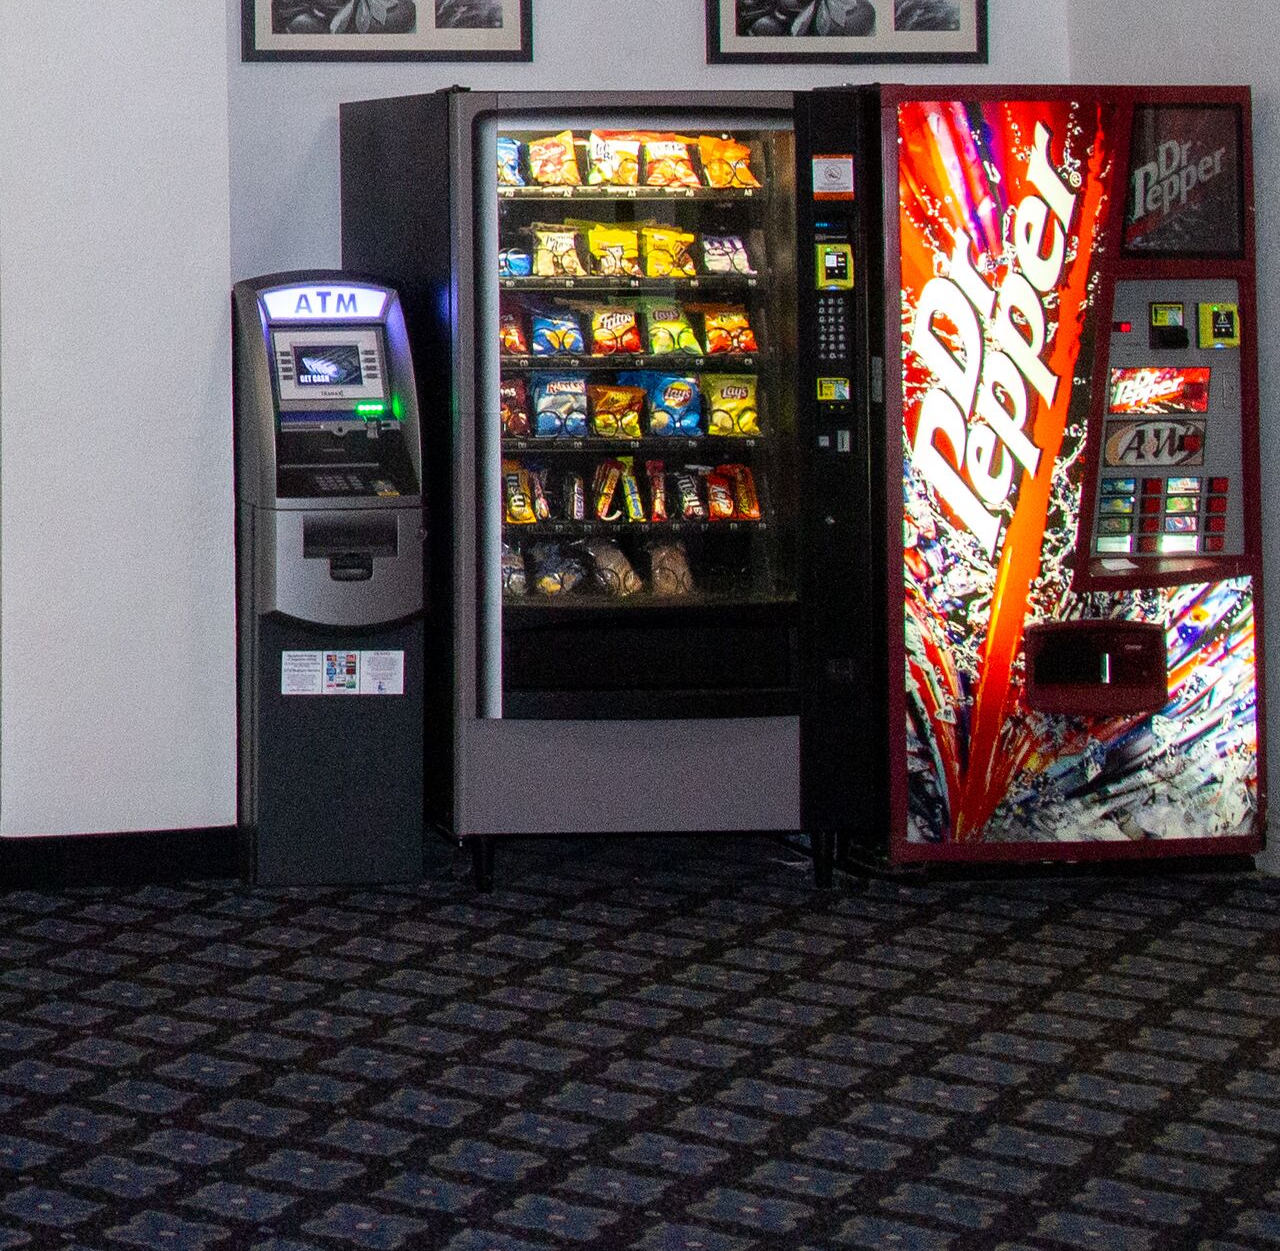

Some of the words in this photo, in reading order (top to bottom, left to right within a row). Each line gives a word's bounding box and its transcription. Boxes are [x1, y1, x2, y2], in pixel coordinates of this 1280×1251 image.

[1157, 139, 1192, 180] Dr
[1132, 147, 1226, 225] Pepper
[295, 291, 358, 313] ATM
[600, 312, 633, 329] Fritos
[911, 226, 999, 418] Dr
[913, 119, 1077, 562] Pepper
[1113, 374, 1185, 407] Pepper
[1134, 369, 1161, 389] Dr
